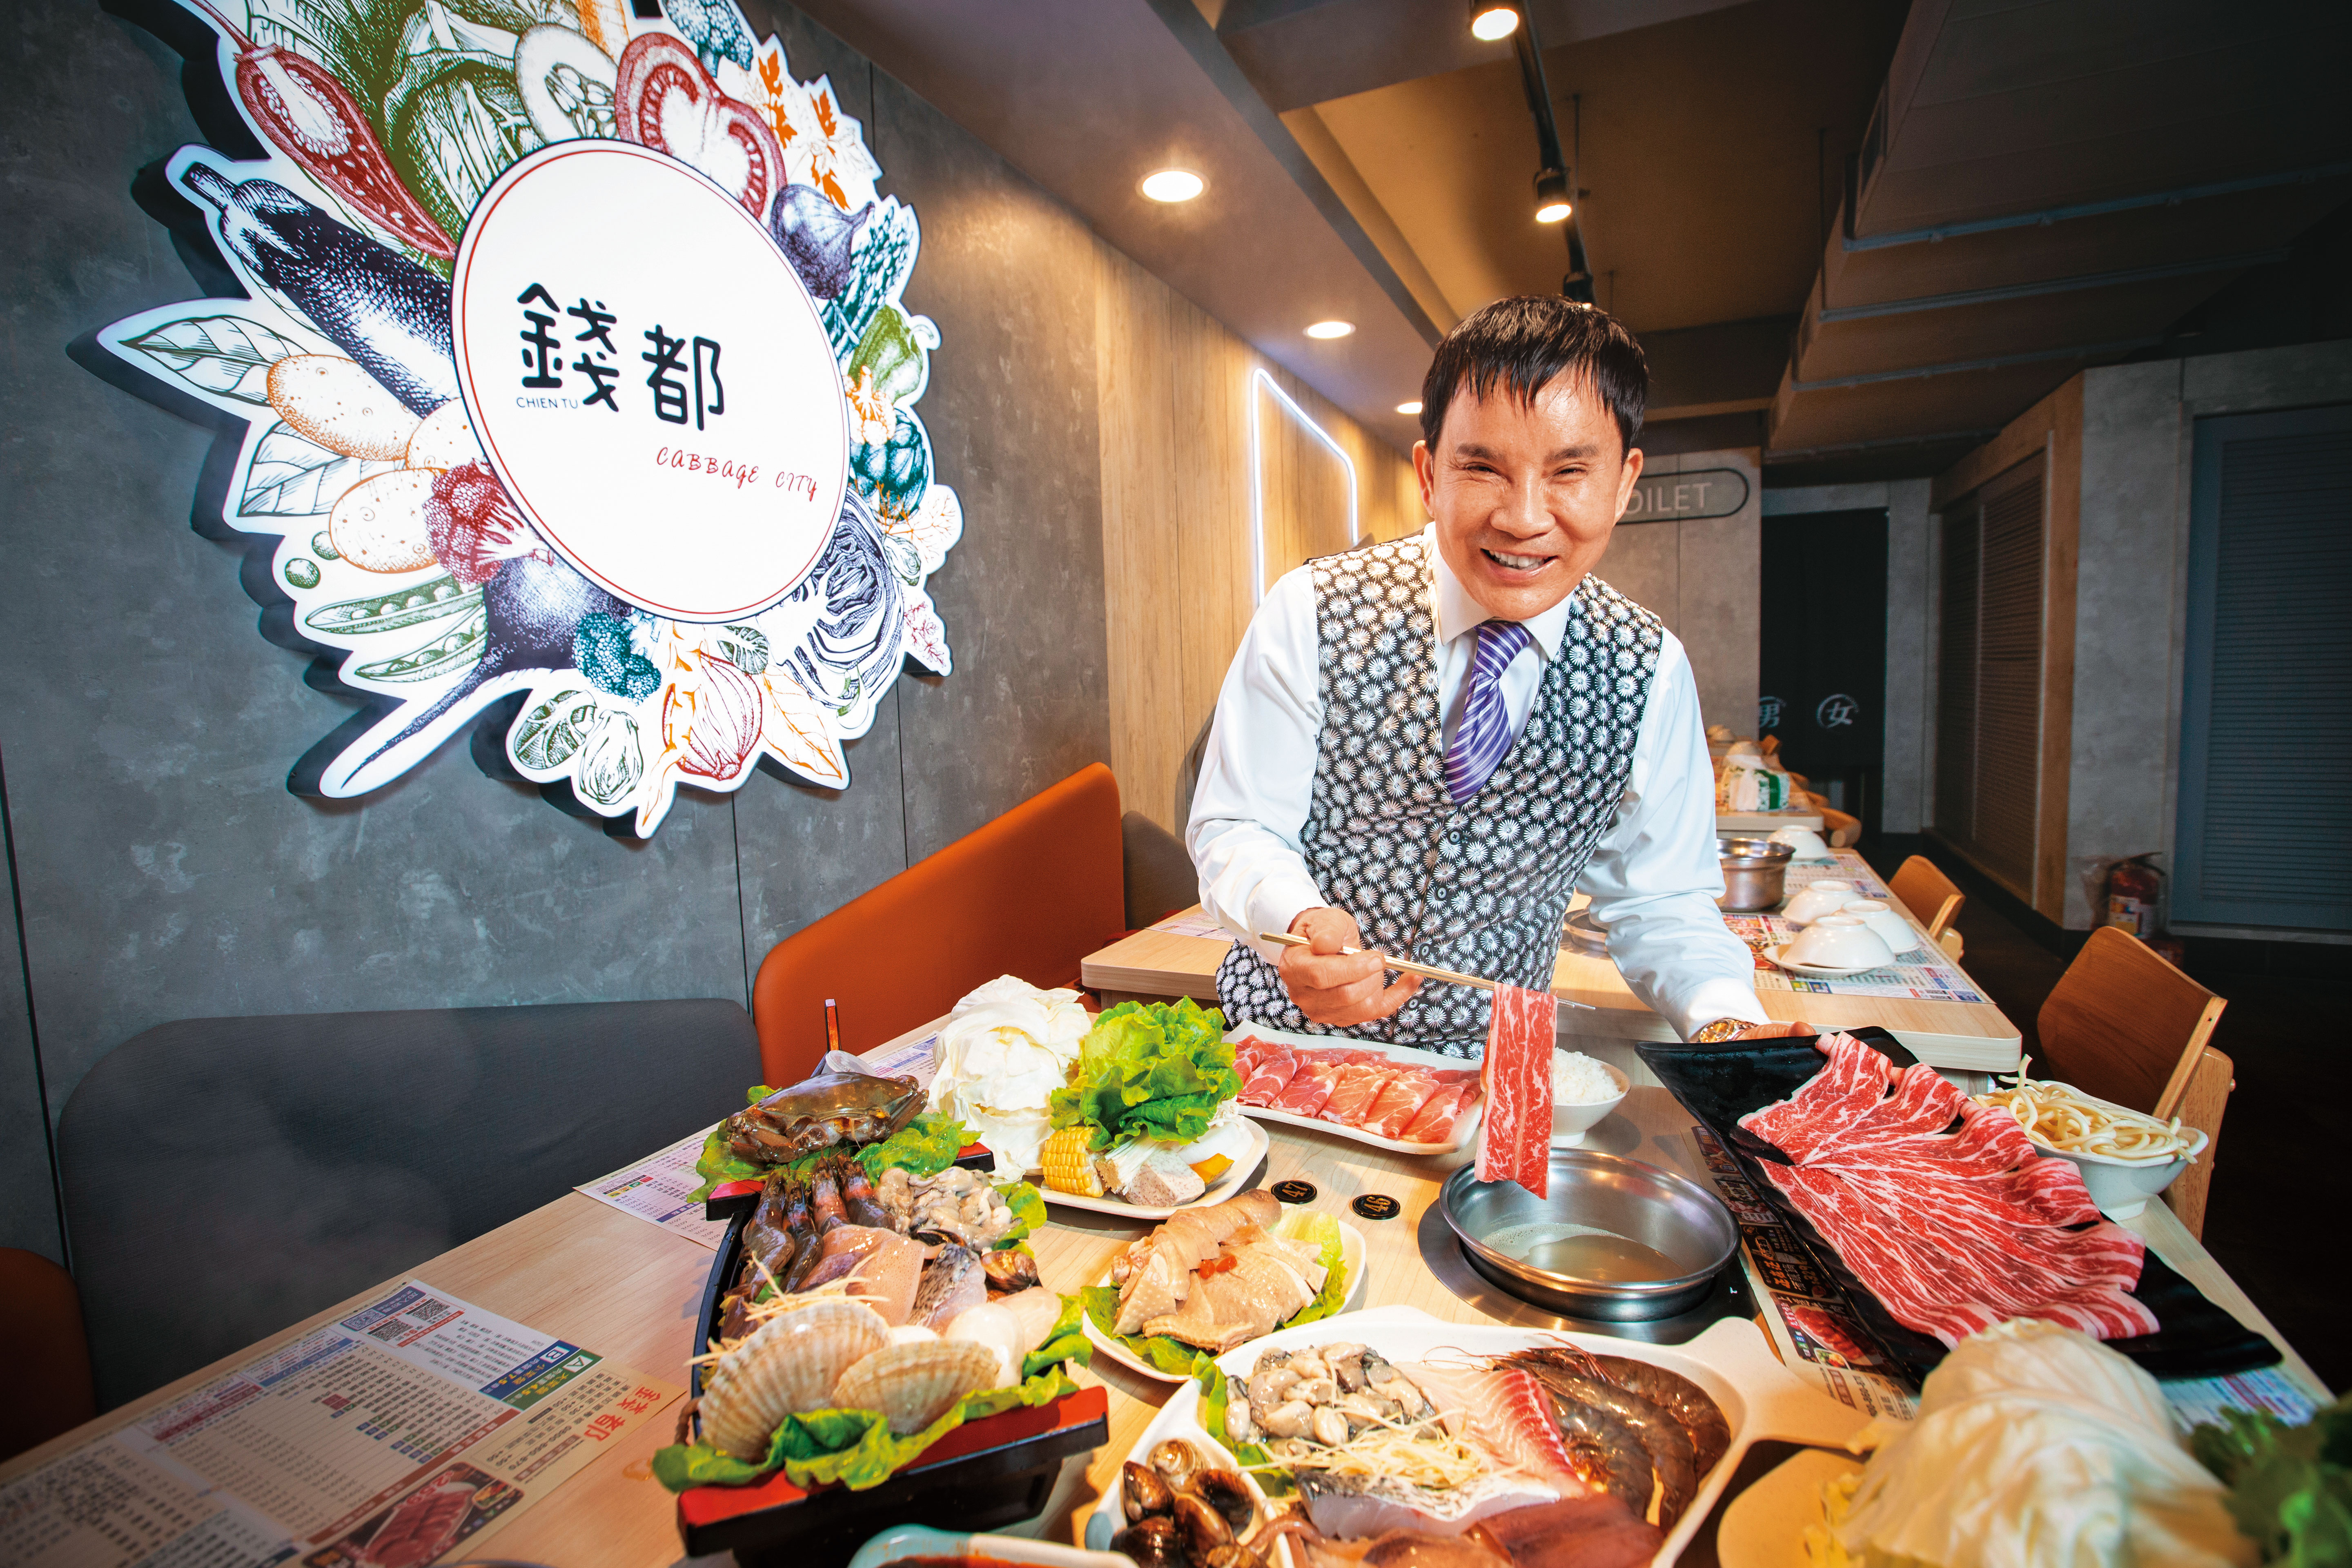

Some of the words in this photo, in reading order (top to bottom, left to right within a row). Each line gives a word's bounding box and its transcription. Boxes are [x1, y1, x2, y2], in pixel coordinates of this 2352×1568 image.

[517, 282, 725, 431] 錢都
[516, 396, 558, 409] CHIEN
[562, 399, 578, 409] TU
[1625, 482, 1711, 514] OILET
[1759, 703, 1780, 728] 男
[1826, 701, 1854, 726] 女
[1282, 1182, 1308, 1198] 47
[1364, 1196, 1391, 1213] 46
[543, 1349, 564, 1360] B
[565, 1356, 590, 1370] A
[576, 1385, 666, 1443] 錢都
